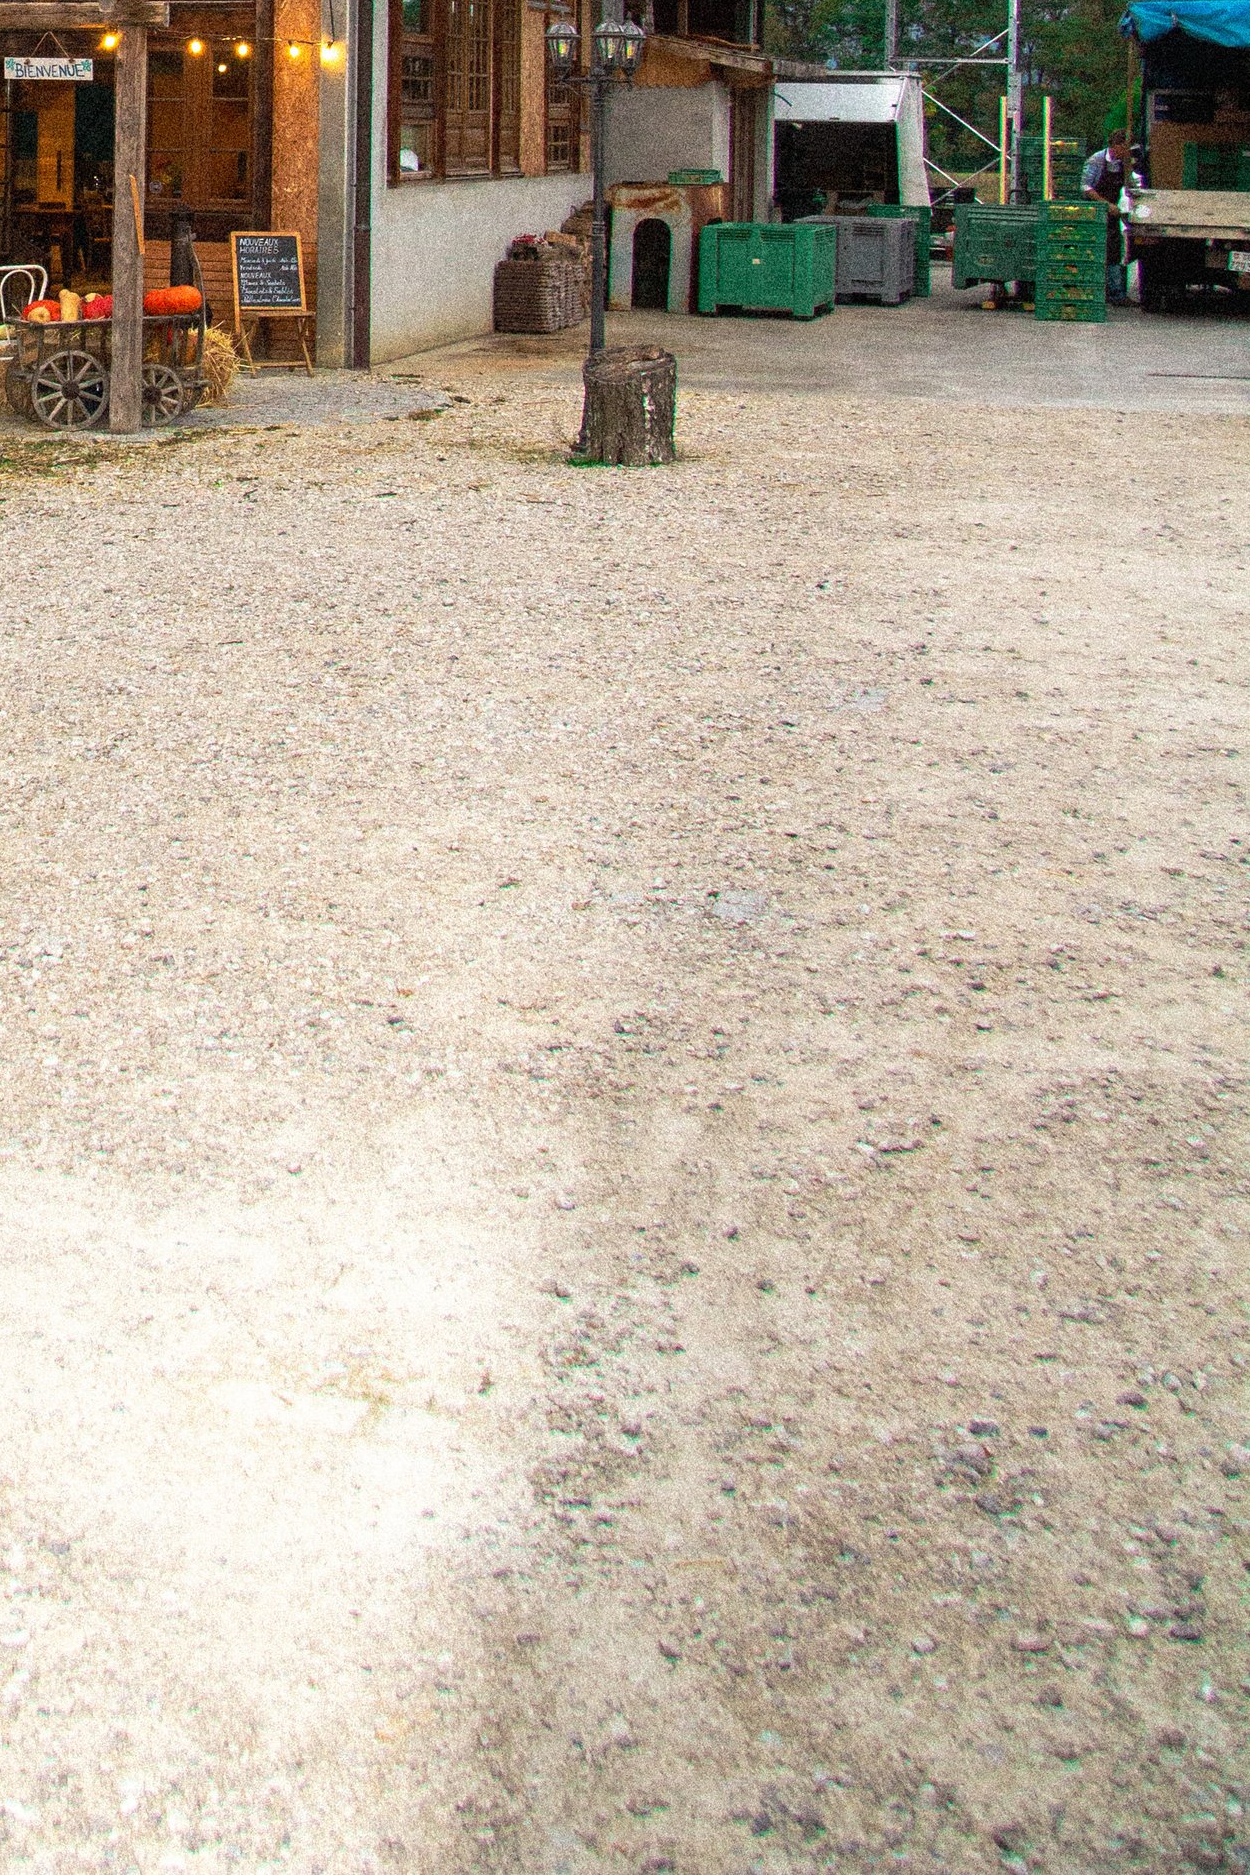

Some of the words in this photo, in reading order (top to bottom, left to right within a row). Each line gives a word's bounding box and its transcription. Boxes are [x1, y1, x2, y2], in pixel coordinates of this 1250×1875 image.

[15, 63, 85, 78] BIENVENUE
[240, 238, 279, 246] NOUVEAUX
[240, 246, 280, 255] HORAIRES
